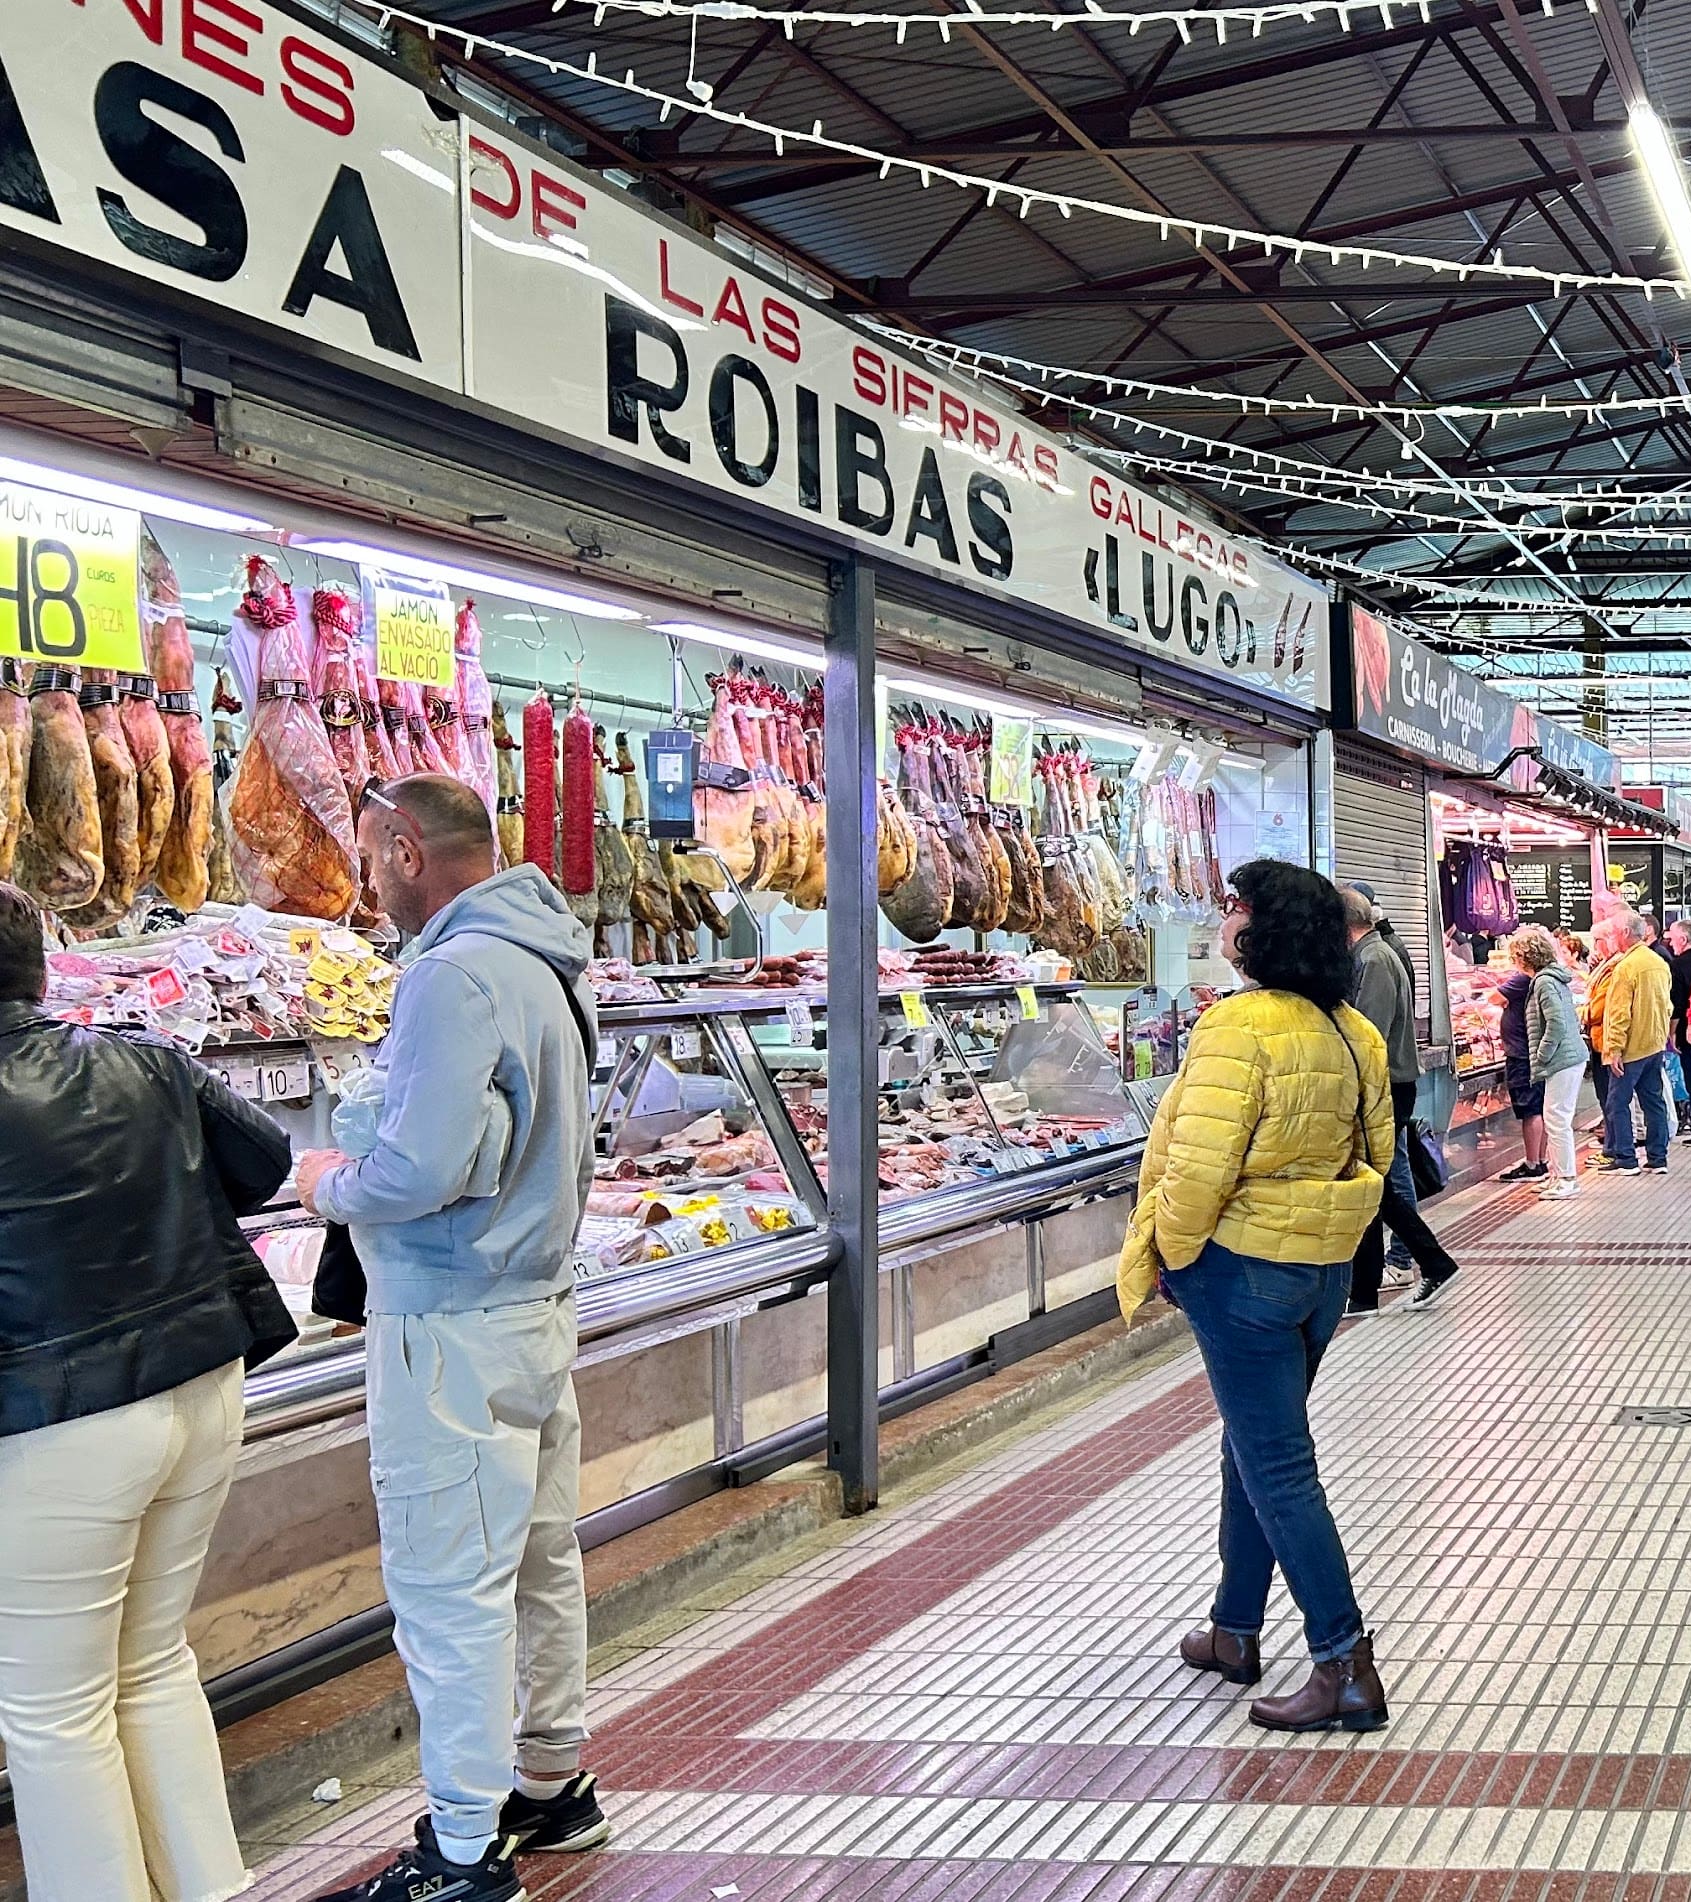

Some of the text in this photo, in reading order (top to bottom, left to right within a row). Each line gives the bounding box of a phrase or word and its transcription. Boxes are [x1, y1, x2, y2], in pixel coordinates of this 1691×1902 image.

[470, 135, 587, 257] DE
[659, 239, 801, 364] LAS
[853, 345, 1059, 488] SIERRAS
[1090, 475, 1248, 588] GALLEGAS
[604, 292, 1012, 581] ROIBAS
[379, 619, 451, 654] ENVASADO
[380, 649, 398, 676] AL
[1400, 644, 1422, 708] Ca
[1424, 657, 1438, 710] la
[1440, 669, 1484, 748] Magda
[1387, 715, 1437, 755] CARNISSERIA
[407, 1875, 444, 1899] EA7
